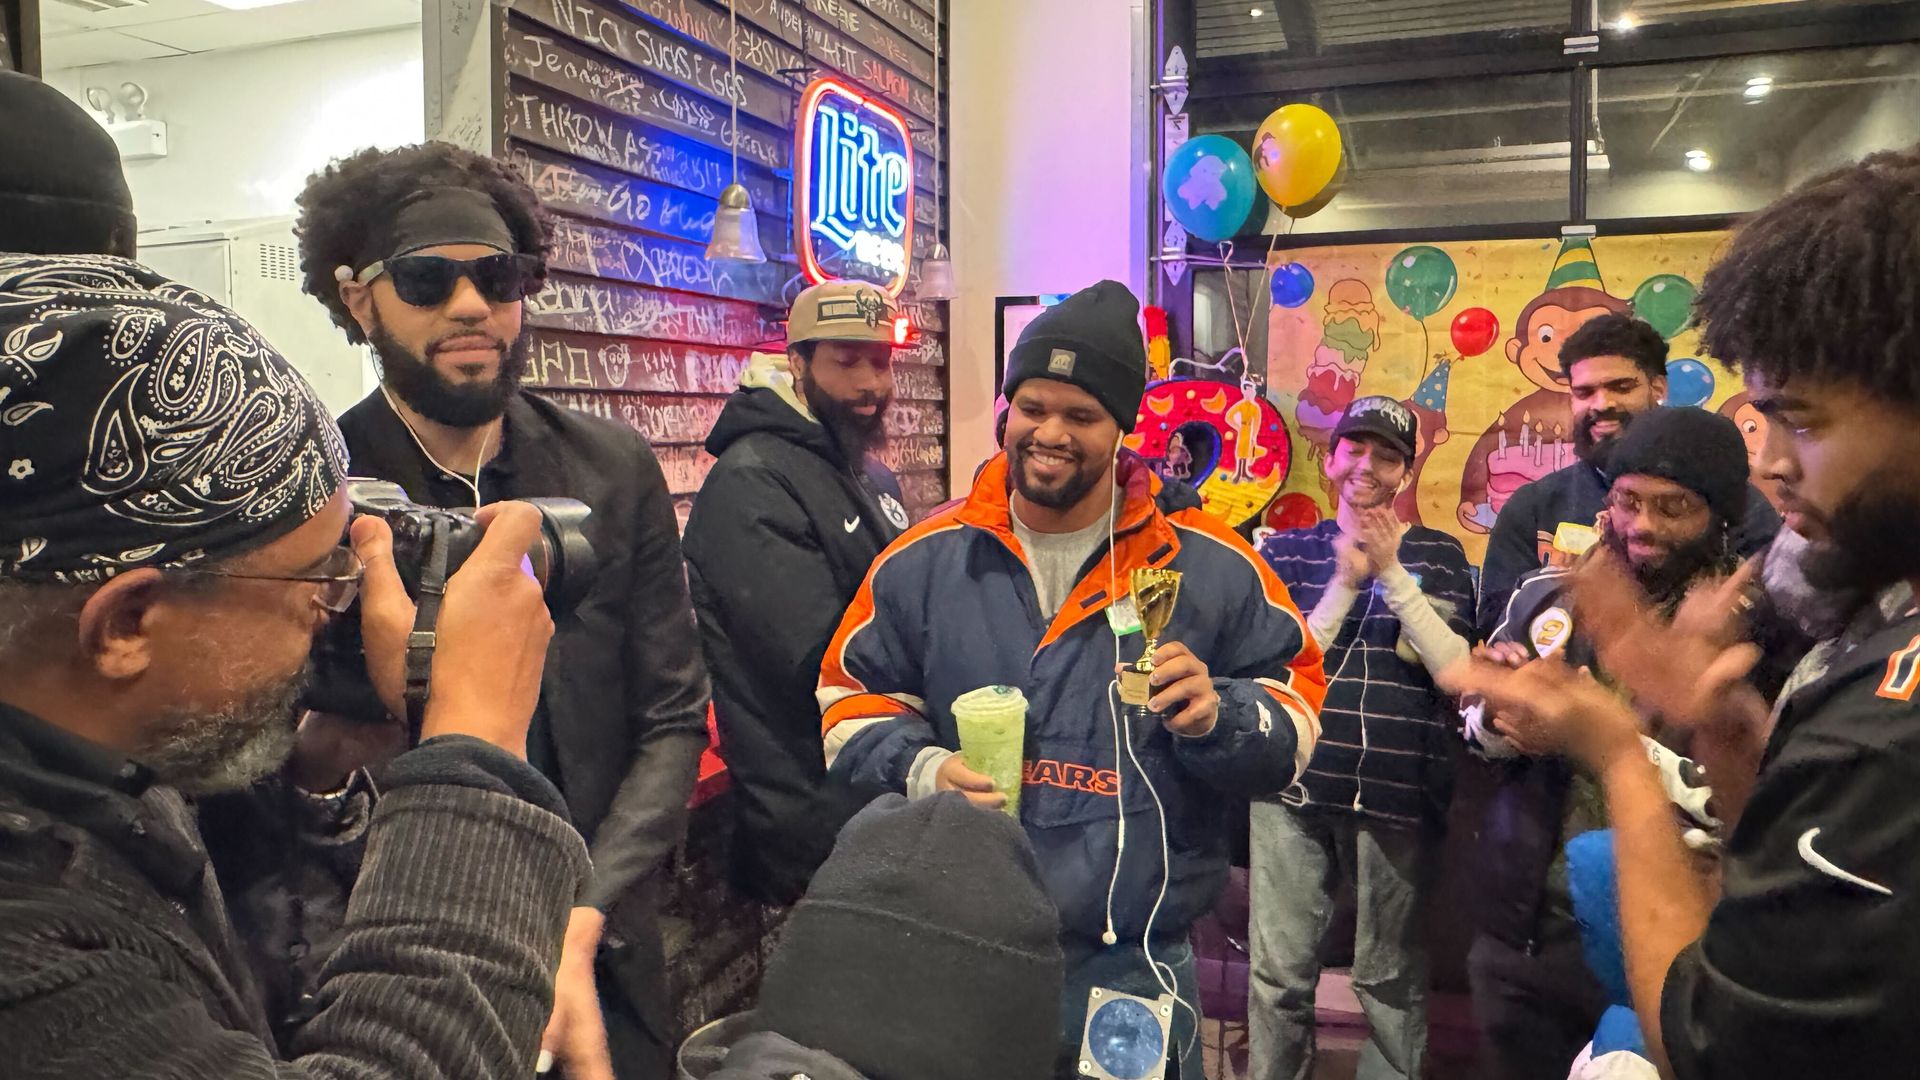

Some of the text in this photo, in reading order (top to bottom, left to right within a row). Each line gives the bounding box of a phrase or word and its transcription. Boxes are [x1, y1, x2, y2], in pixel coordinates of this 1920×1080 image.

[635, 29, 692, 80] SUCKS
[810, 105, 909, 250] Lite
[1536, 619, 1565, 646] 2
[1022, 759, 1121, 796] ARS
